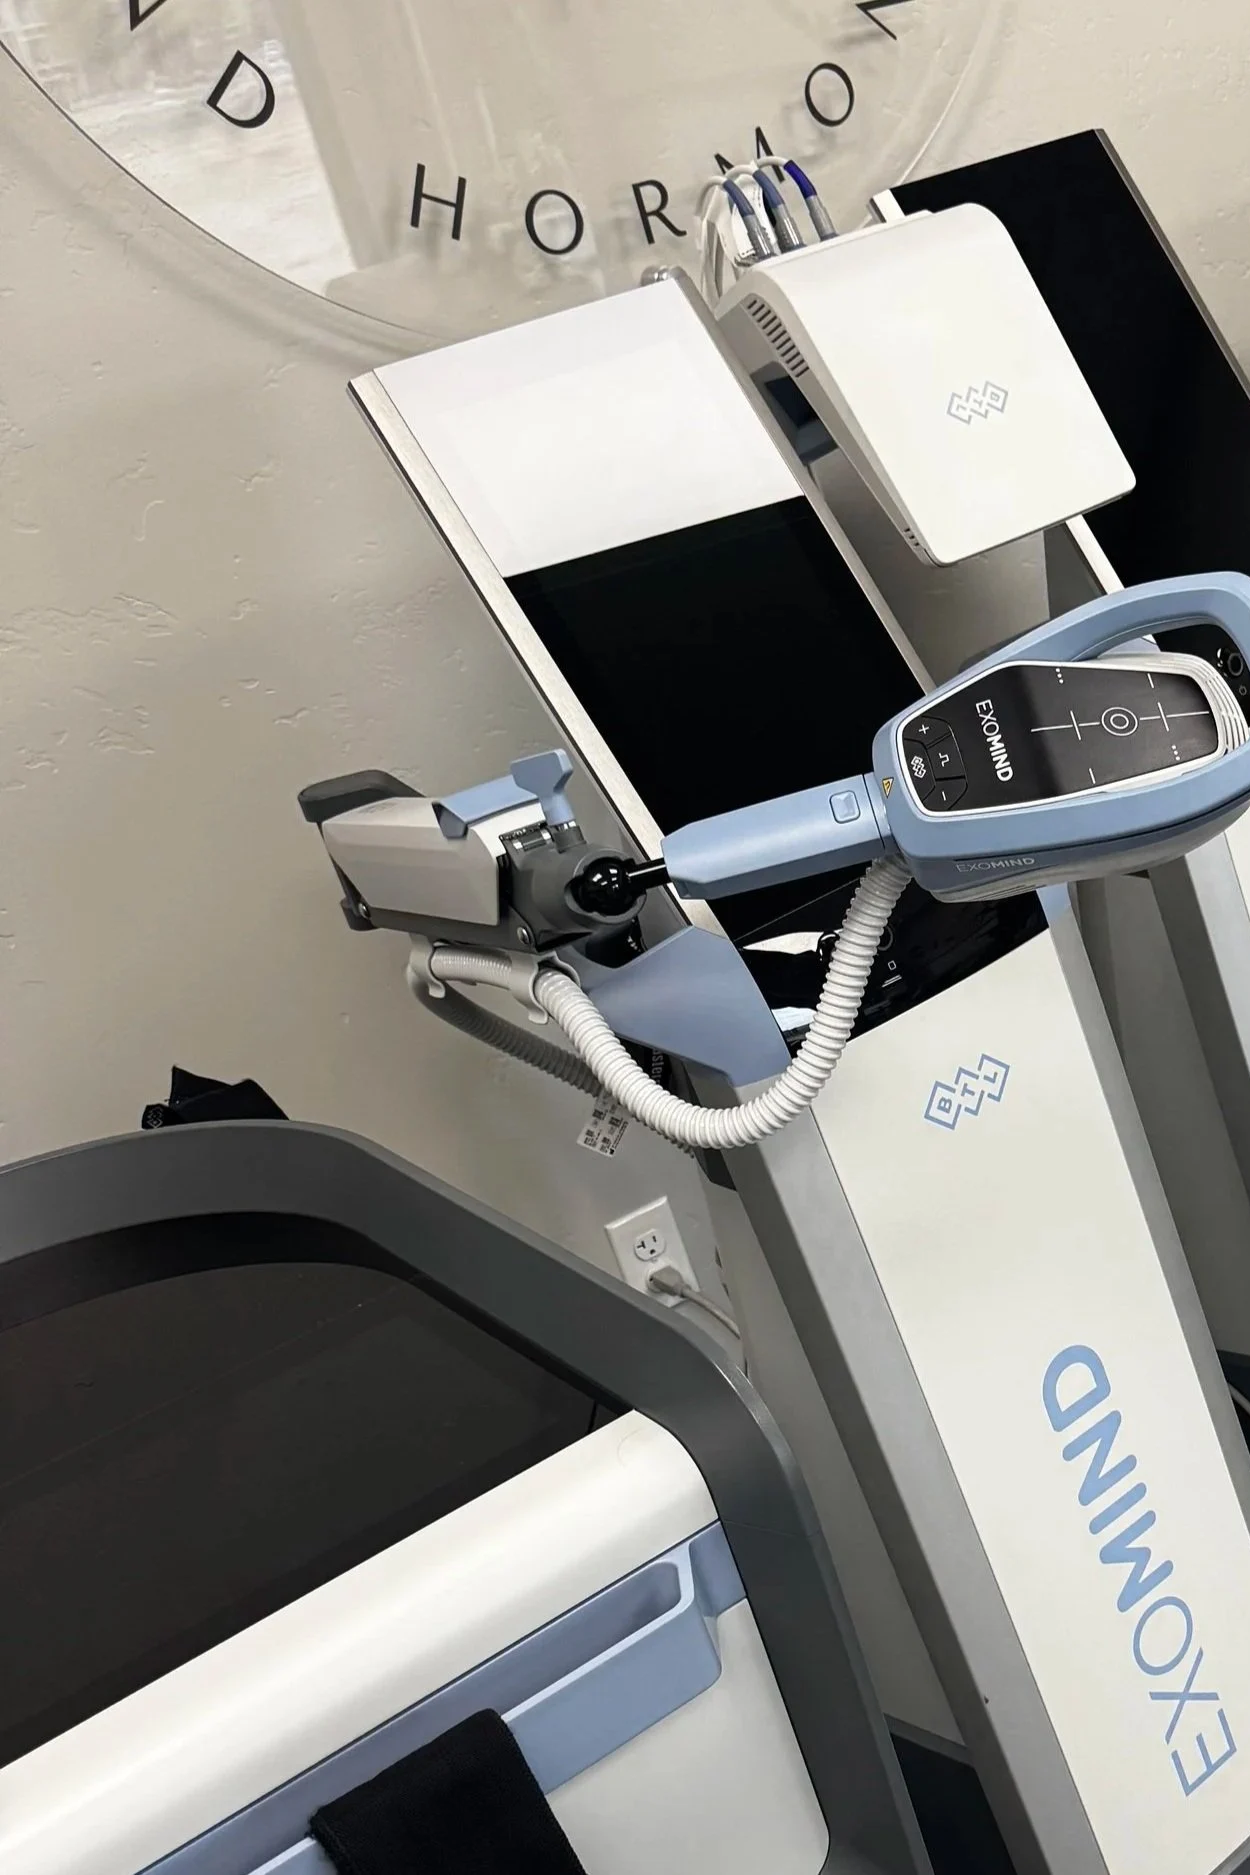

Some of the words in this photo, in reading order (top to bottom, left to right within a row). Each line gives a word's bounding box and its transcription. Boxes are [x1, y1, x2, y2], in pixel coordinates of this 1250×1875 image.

[975, 698, 1014, 782] EXOMIND
[955, 857, 1036, 873] EXOMIND
[933, 1063, 1003, 1117] BTL
[1042, 1344, 1237, 1797] EXOMIND
